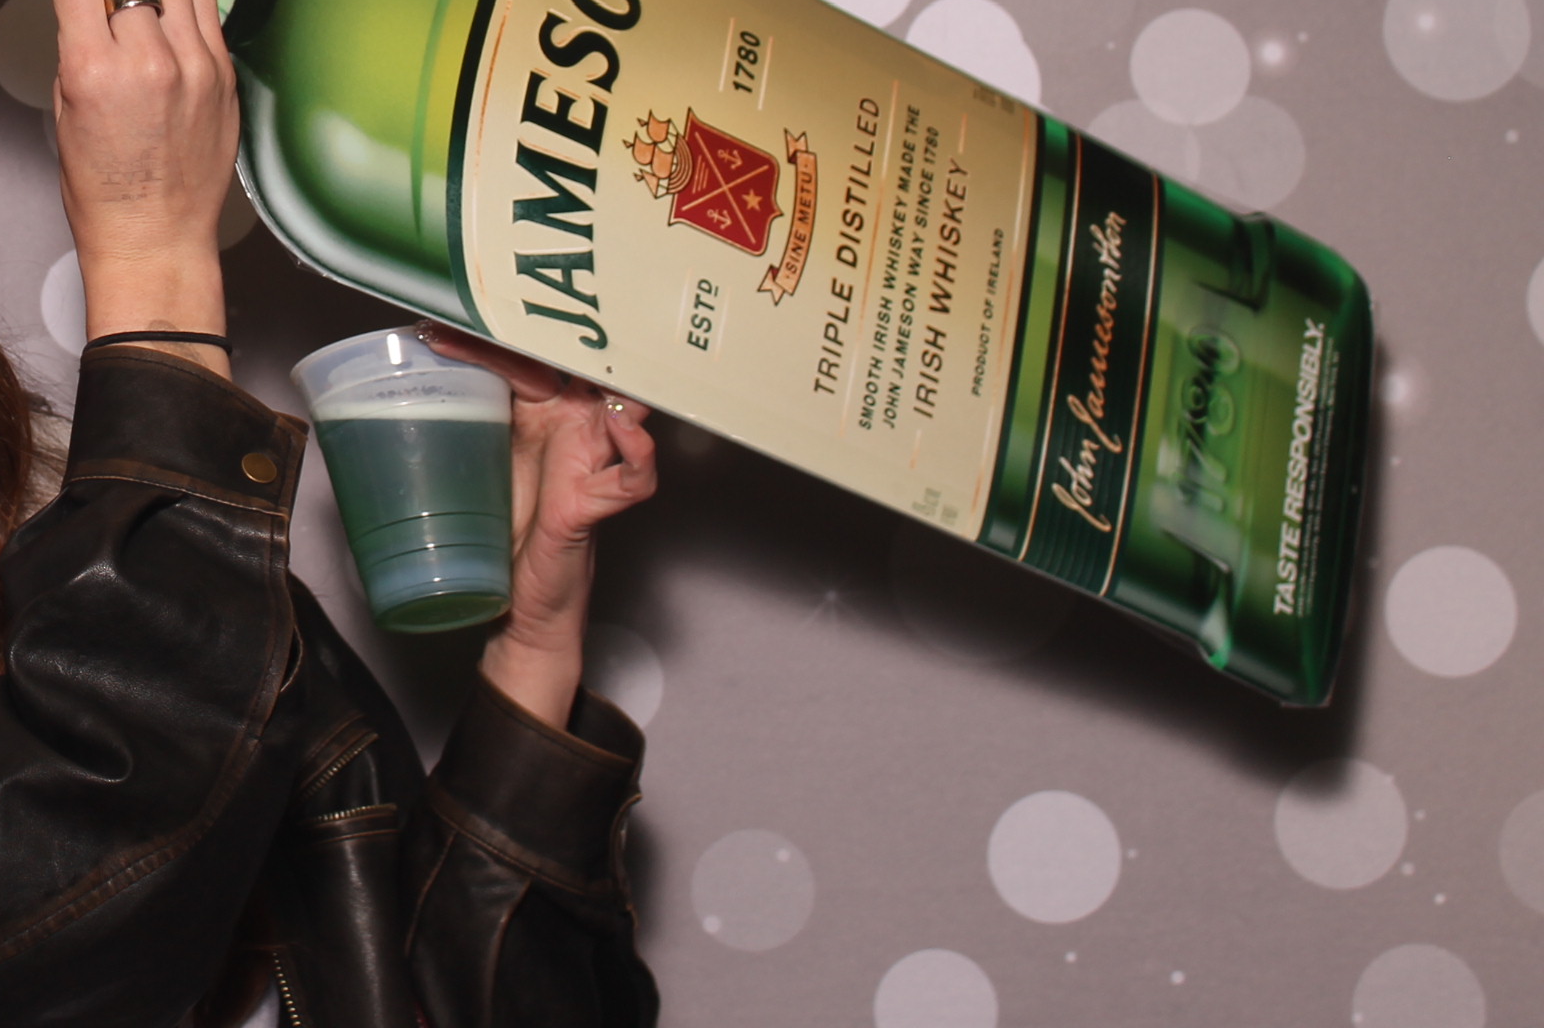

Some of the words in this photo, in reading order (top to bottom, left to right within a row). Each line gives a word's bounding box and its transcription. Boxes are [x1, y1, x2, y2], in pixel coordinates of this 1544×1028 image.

[732, 30, 762, 95] 1780
[906, 104, 921, 137] THE
[924, 126, 940, 165] 1780
[897, 140, 916, 192] MADE
[915, 169, 935, 228] SINCE
[784, 229, 807, 275] SINE
[797, 171, 813, 225] METU
[813, 277, 853, 395] TRIPLE
[835, 97, 880, 269] DISTILLED
[883, 195, 907, 290] WHISKEY
[907, 231, 925, 276] WAY
[928, 157, 969, 315] WHISKEY
[986, 227, 1004, 295] IRELAND
[872, 296, 893, 352] IRISH
[892, 283, 918, 379] JAMESON
[983, 298, 994, 321] OF
[859, 356, 883, 430] SMOOTH
[913, 325, 947, 419] IRISH
[971, 323, 991, 397] PRODUCT
[882, 382, 902, 429] JOHN
[1283, 317, 1325, 523] RESPONSIBLY.
[1051, 439, 1112, 534] John
[1273, 520, 1302, 615] TASTE
